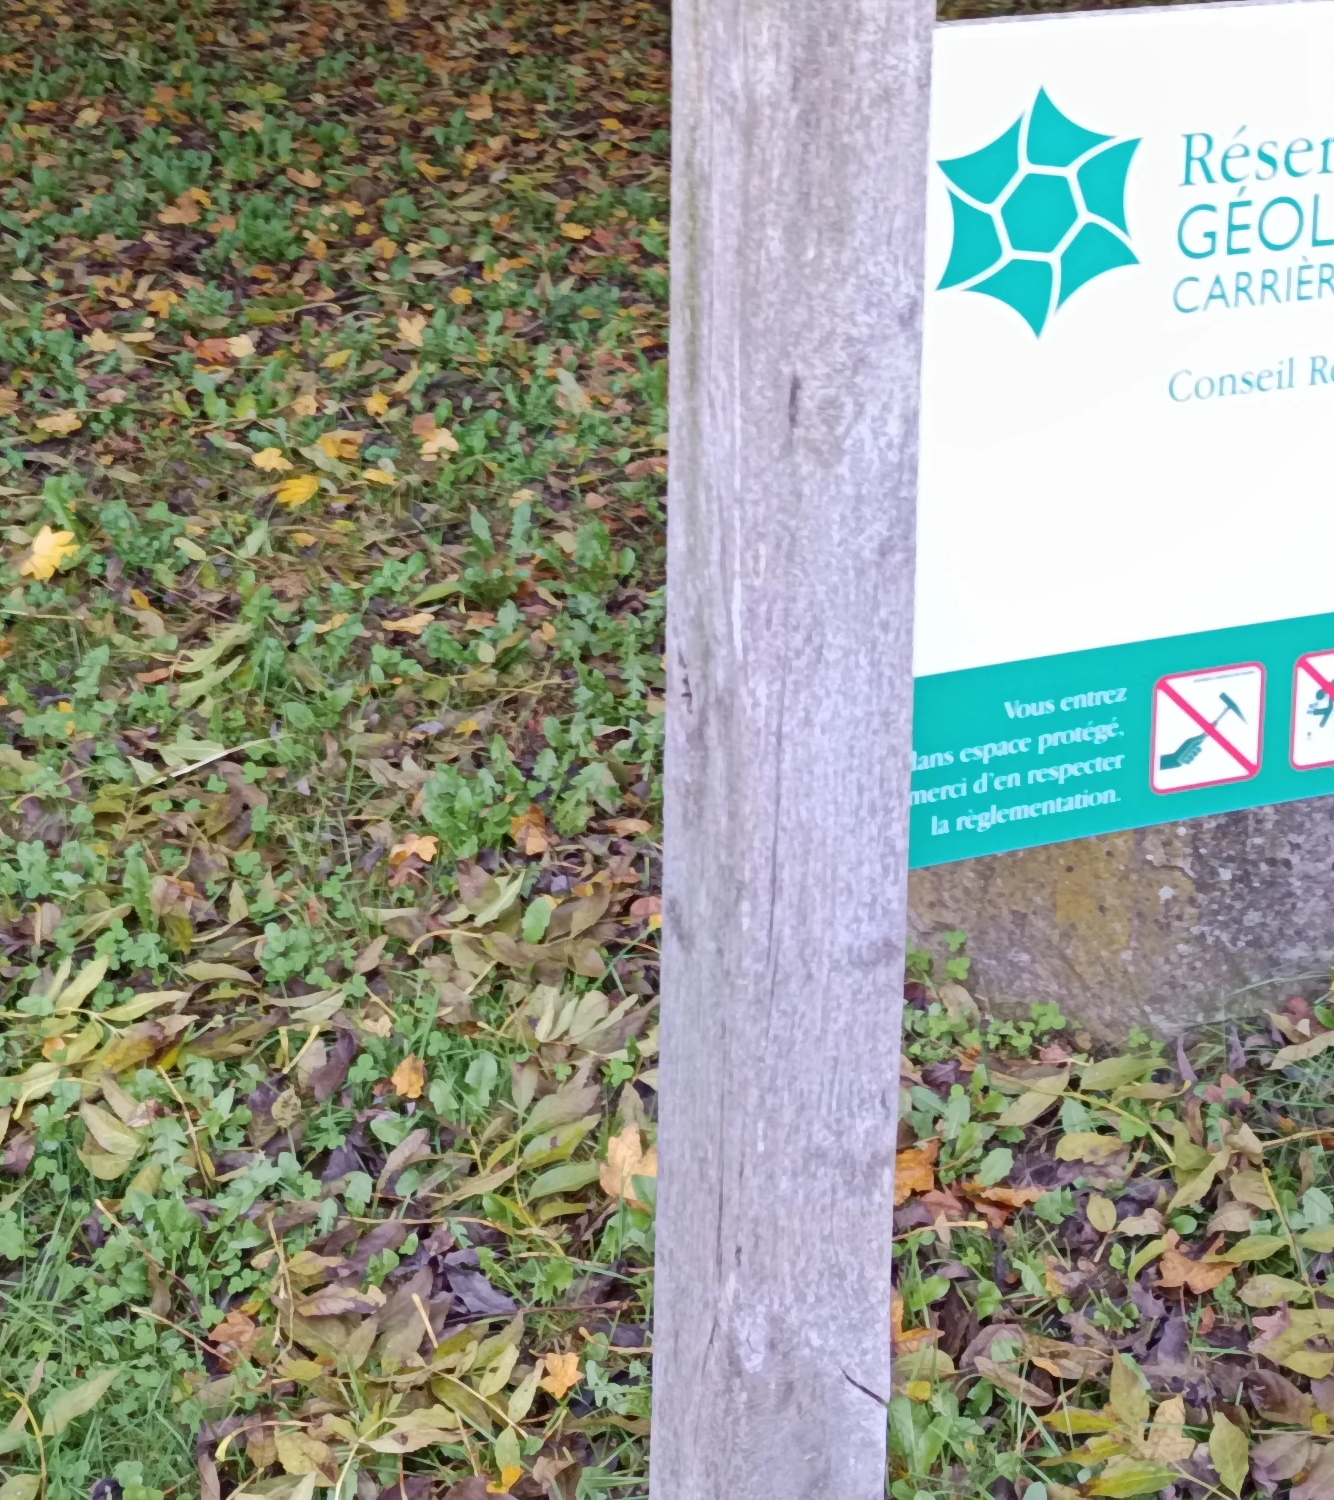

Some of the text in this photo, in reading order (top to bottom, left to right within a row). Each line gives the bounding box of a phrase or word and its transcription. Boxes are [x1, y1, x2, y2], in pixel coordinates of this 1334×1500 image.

[1168, 357, 1295, 402] Conseil
[1004, 687, 1127, 719] Vous entrez
[960, 736, 1031, 764] espace
[910, 754, 1125, 805] merci d'en respecter
[931, 815, 949, 836] la
